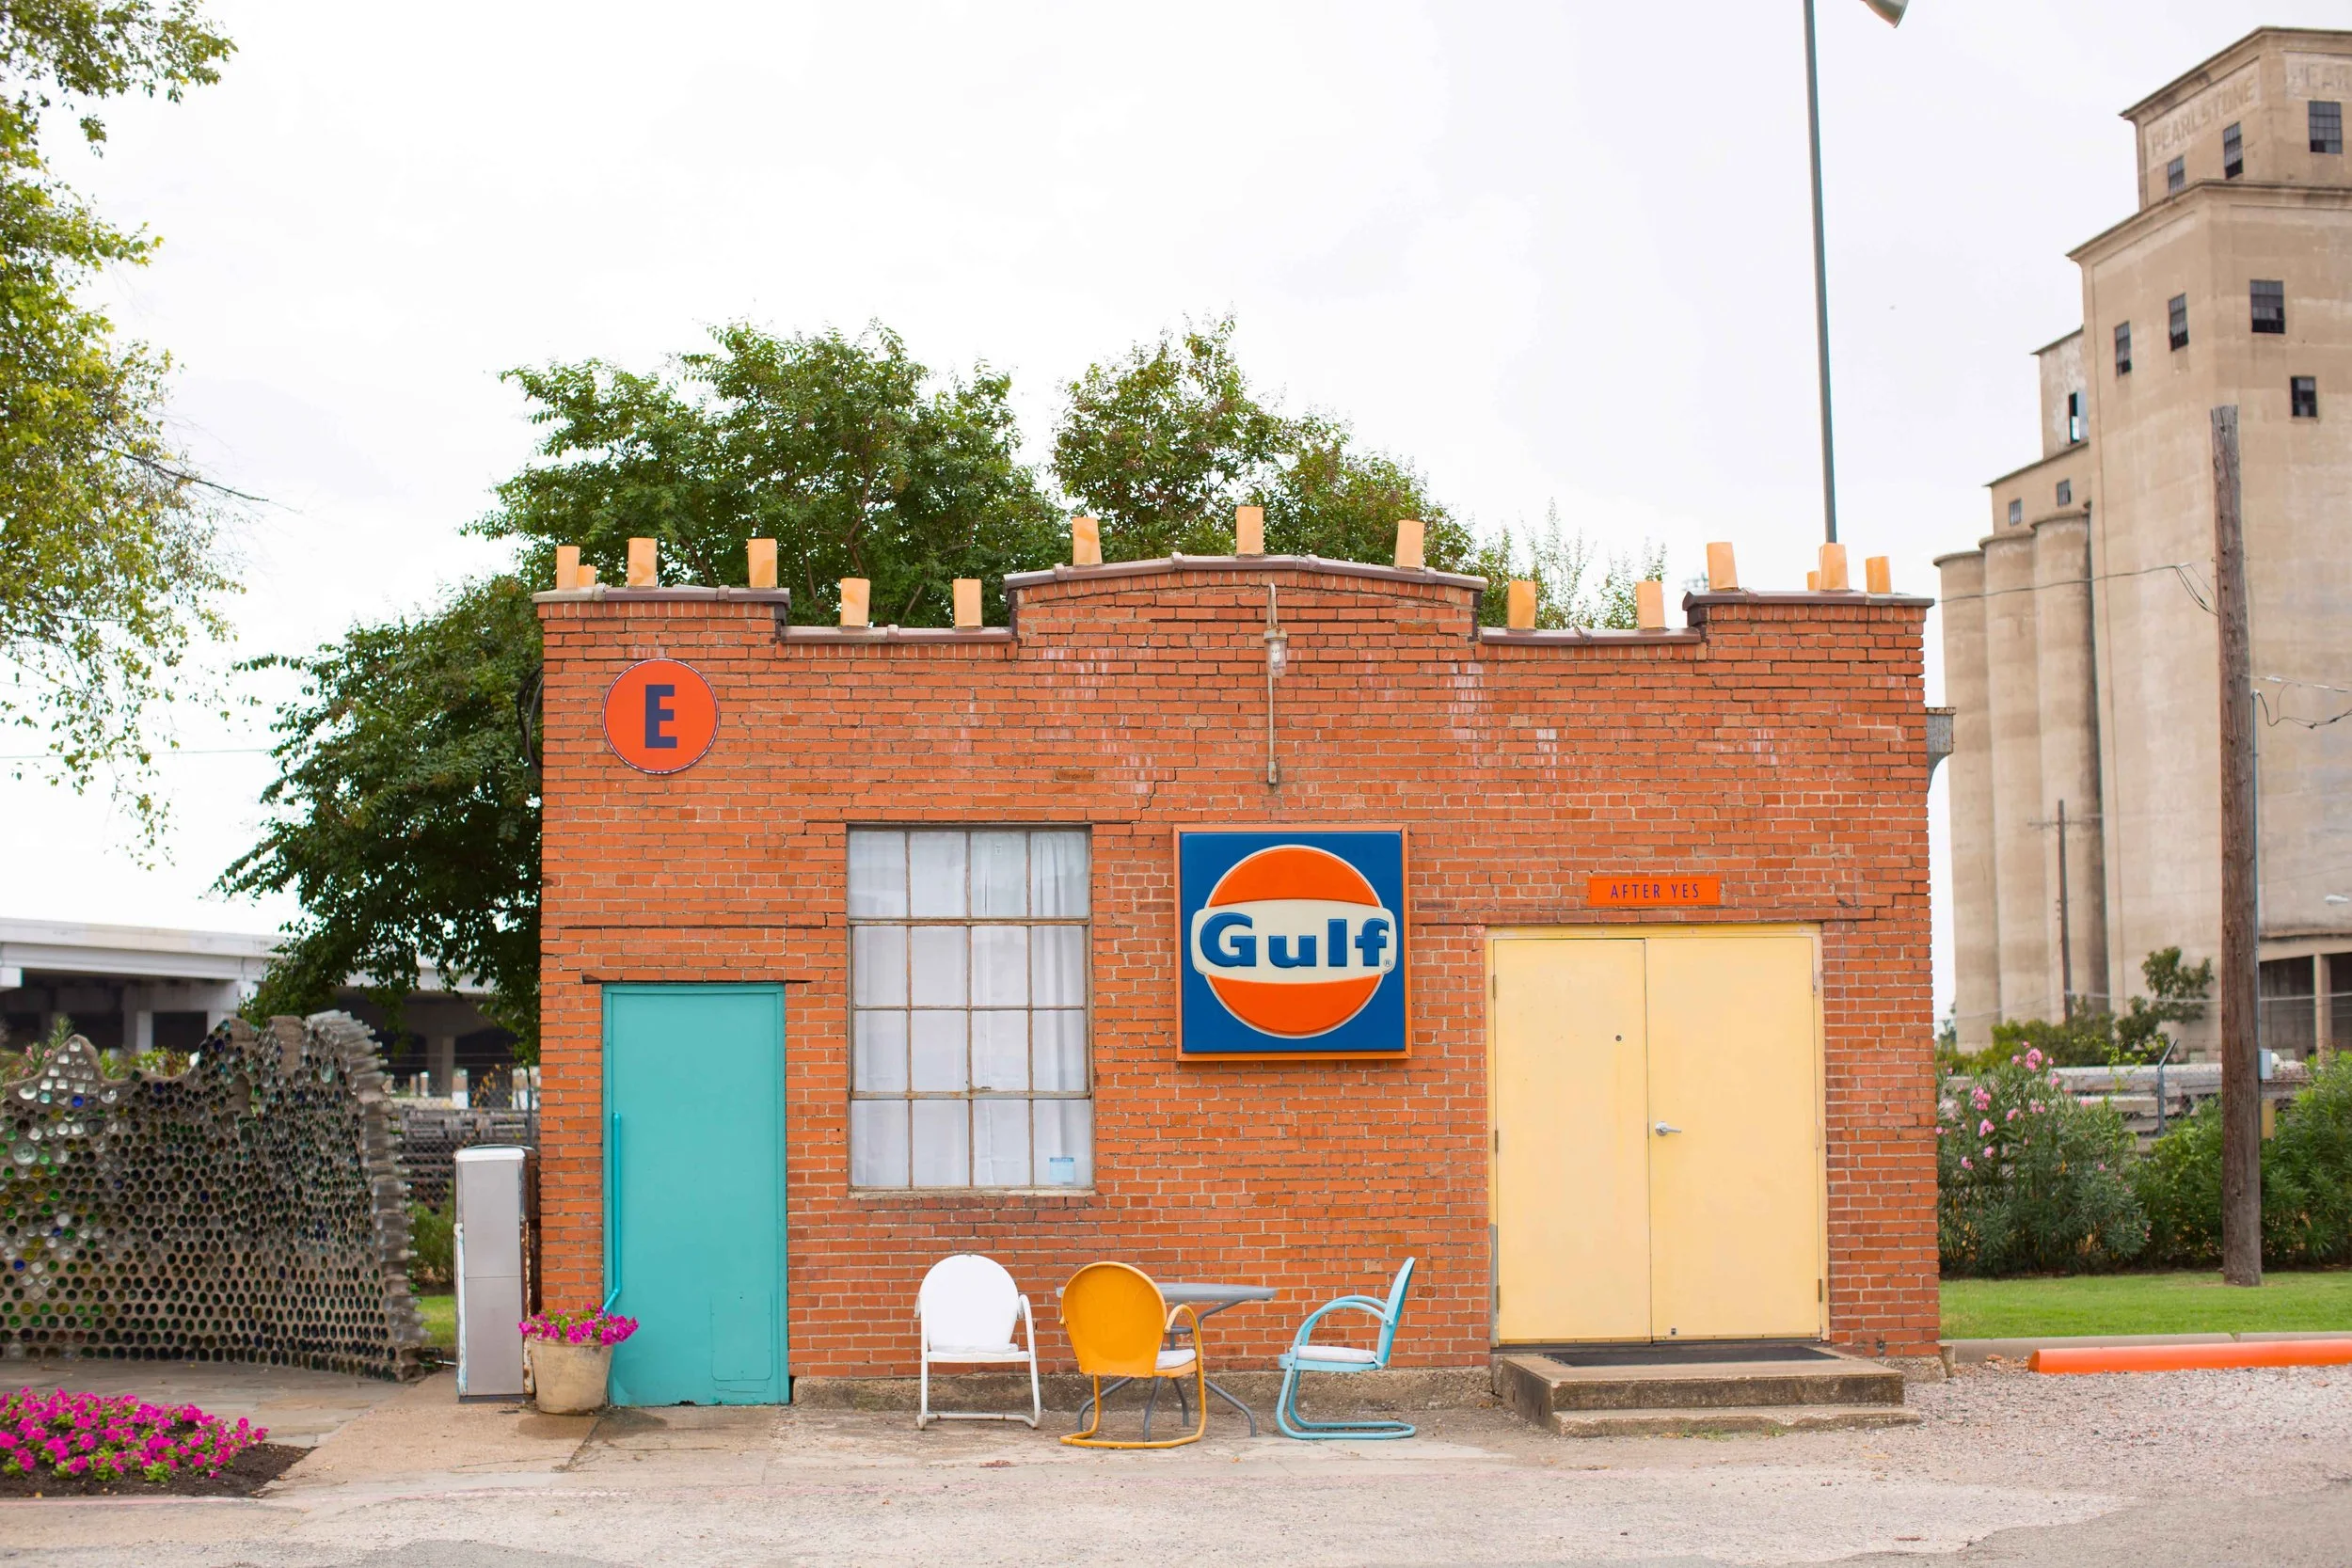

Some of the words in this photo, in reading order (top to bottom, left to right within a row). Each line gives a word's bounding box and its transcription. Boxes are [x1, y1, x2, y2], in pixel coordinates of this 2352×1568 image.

[2152, 74, 2255, 157] PEARLSTONE
[644, 684, 677, 749] E
[1610, 884, 1661, 899] AFTER
[1671, 883, 1699, 898] YES
[1200, 911, 1390, 969] Gulf
